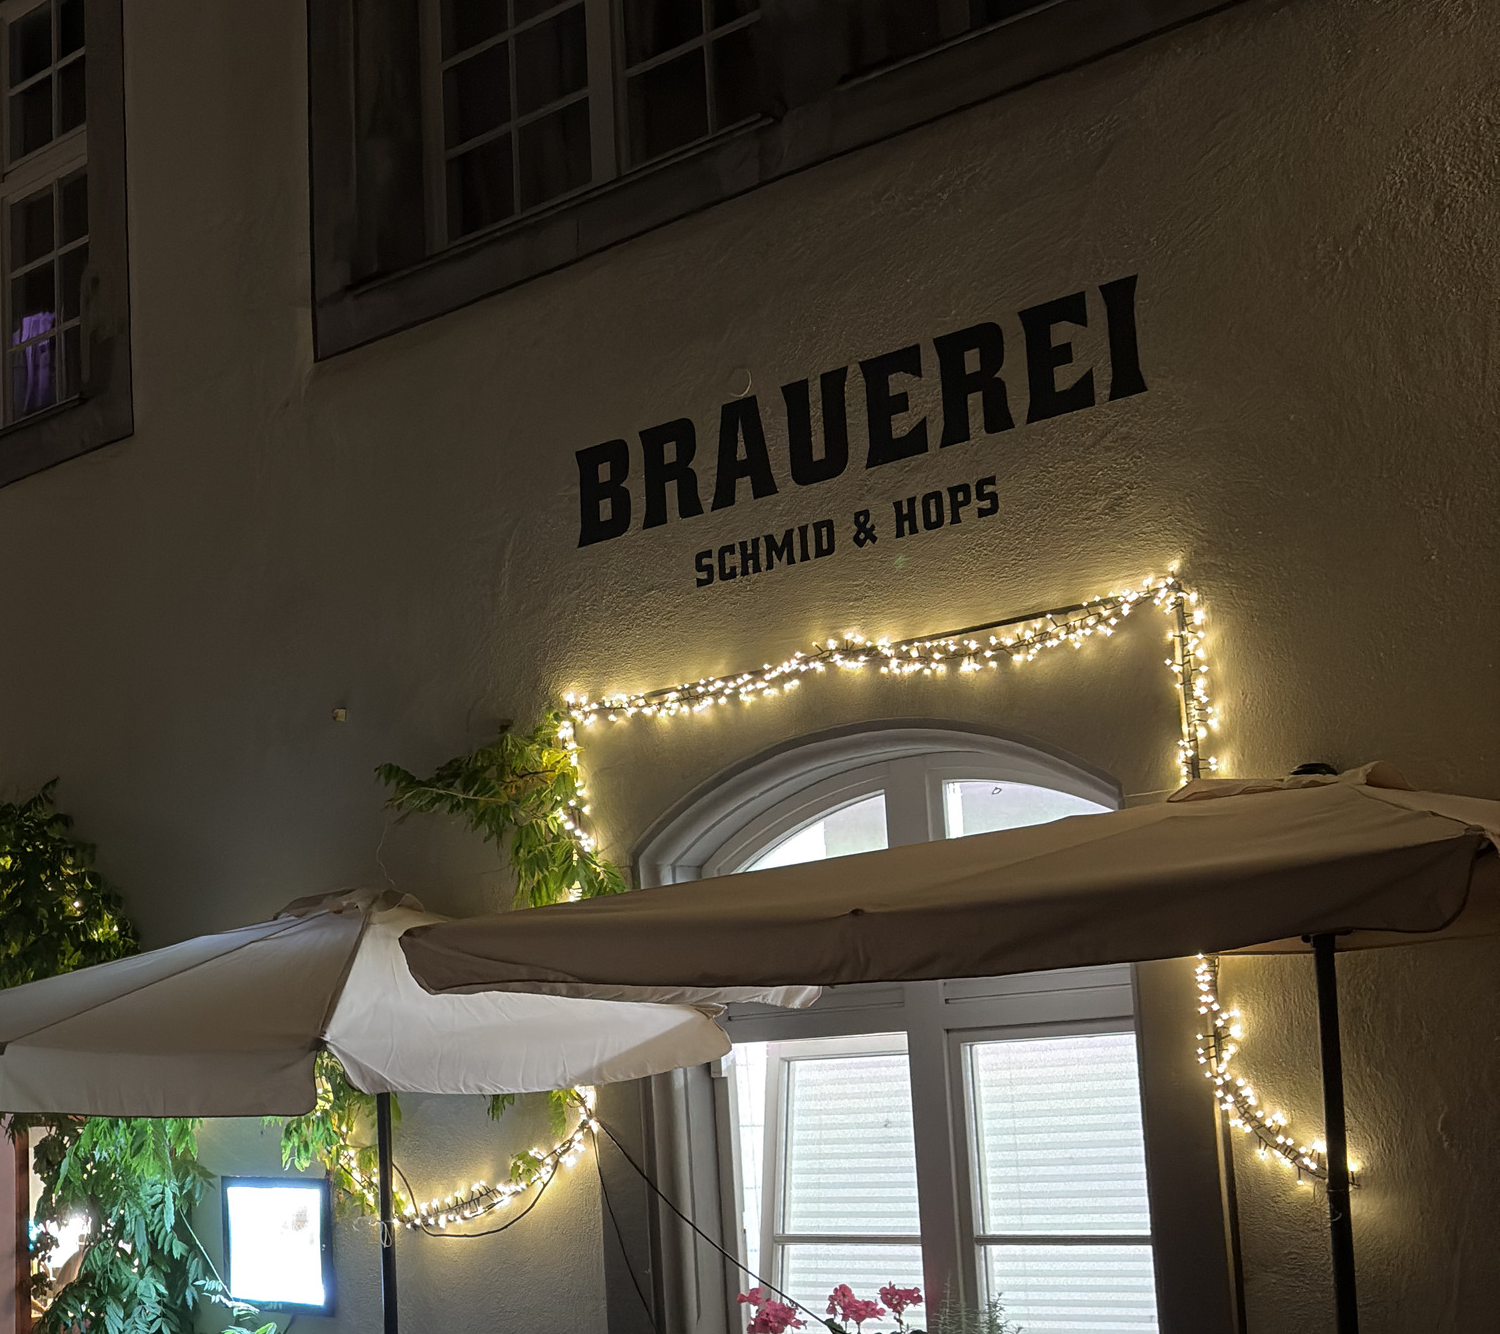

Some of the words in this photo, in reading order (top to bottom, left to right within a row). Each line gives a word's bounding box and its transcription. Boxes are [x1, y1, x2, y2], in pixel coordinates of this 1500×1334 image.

[575, 274, 1148, 548] BRAUEREI
[695, 519, 835, 587] SCHMID
[852, 509, 879, 548] &
[892, 475, 1000, 539] HOPS
